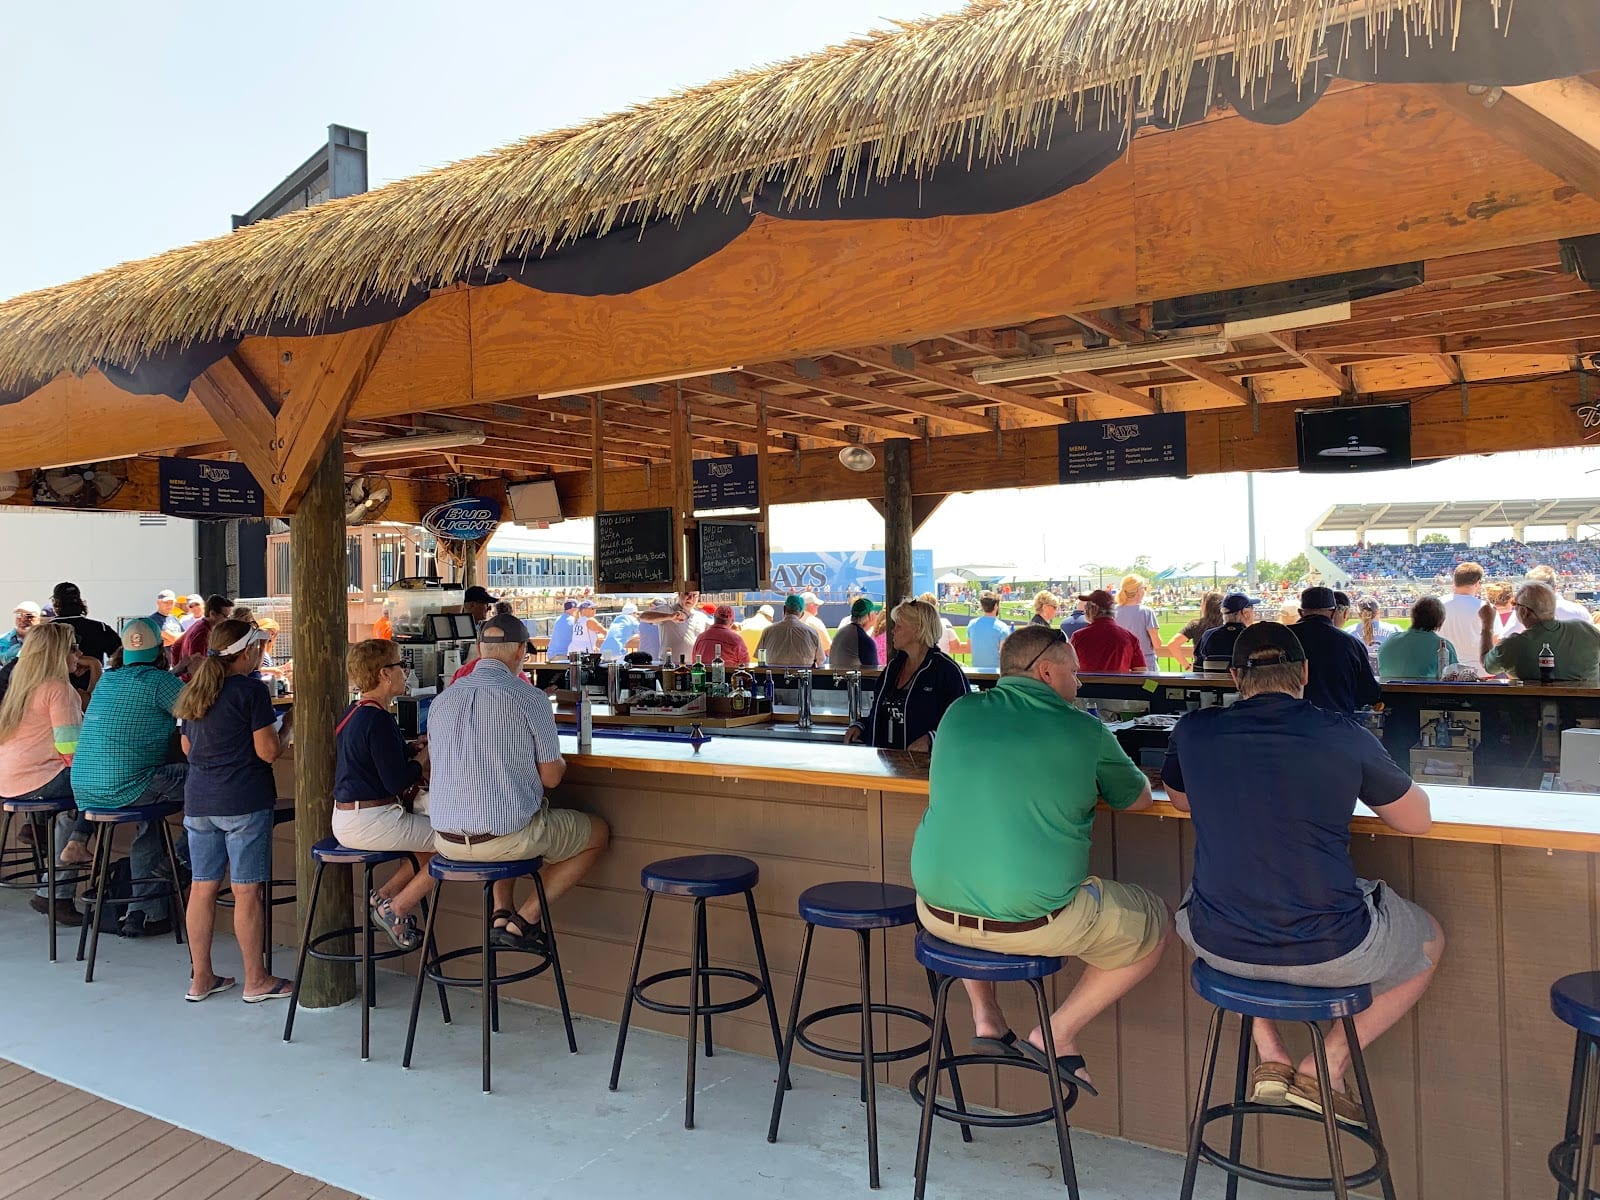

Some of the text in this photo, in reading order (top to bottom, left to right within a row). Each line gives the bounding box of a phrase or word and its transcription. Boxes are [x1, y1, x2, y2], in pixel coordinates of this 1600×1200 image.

[445, 508, 491, 519] BUD
[436, 519, 497, 530] LIGHT
[600, 516, 635, 526] BUD LIGHT
[771, 563, 827, 589] AYS
